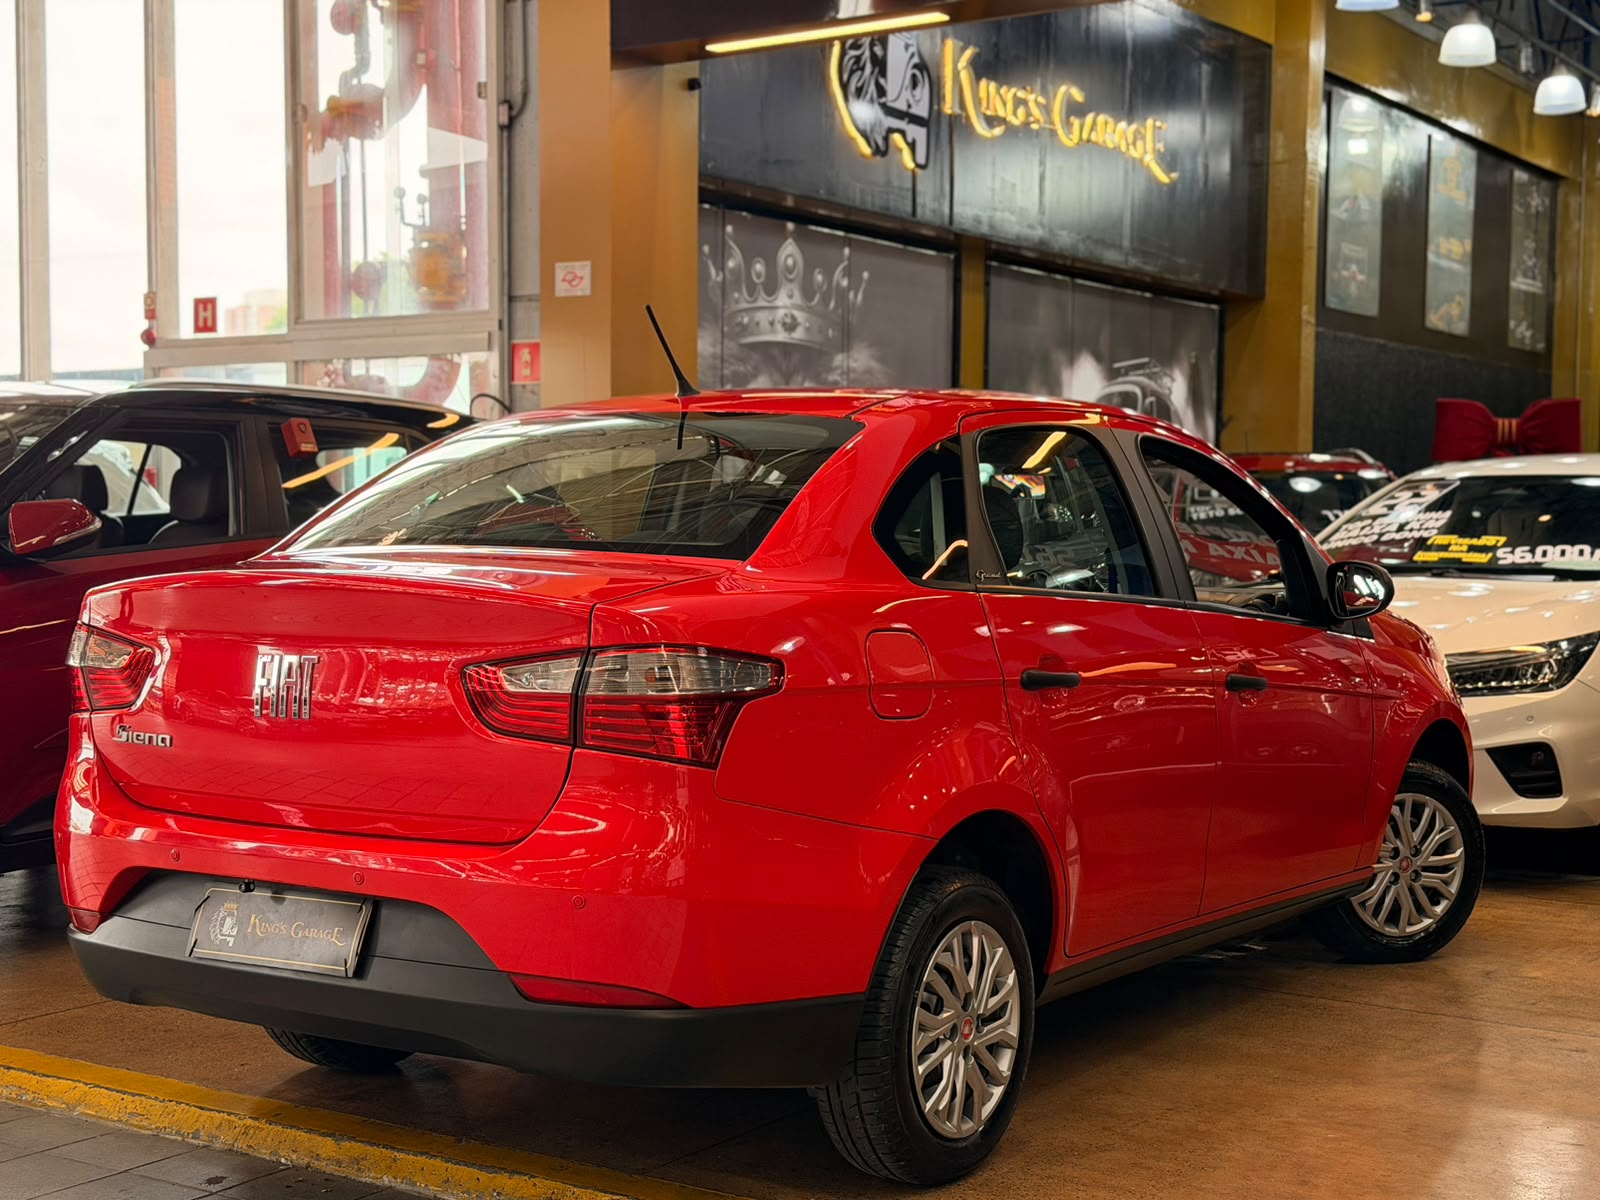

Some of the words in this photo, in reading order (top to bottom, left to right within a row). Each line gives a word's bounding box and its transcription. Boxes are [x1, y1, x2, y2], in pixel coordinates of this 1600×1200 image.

[1053, 83, 1179, 184] GARAGE
[198, 302, 213, 328] H
[253, 654, 320, 720] FIAT
[112, 724, 173, 748] Siena
[247, 914, 288, 937] KING'S
[290, 921, 346, 946] GARAGE
